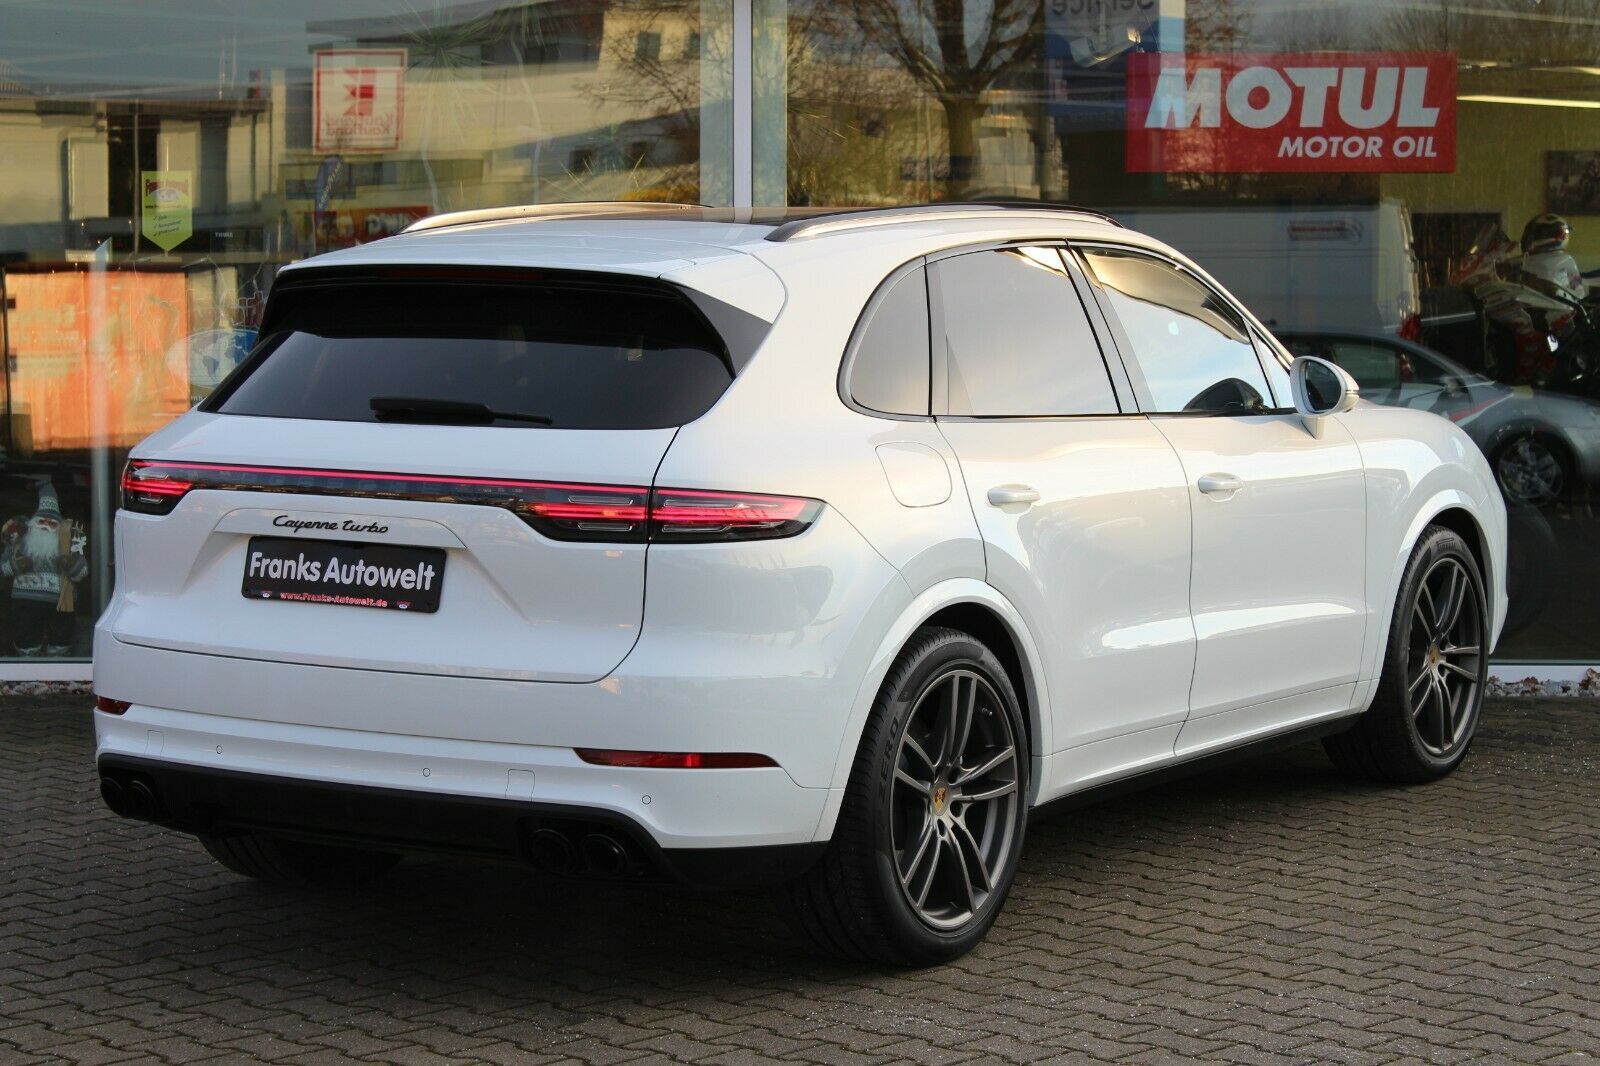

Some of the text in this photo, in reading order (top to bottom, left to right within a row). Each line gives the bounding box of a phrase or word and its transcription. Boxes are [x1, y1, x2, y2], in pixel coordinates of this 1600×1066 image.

[1144, 66, 1440, 129] MOTUL
[1277, 136, 1437, 158] MOTOR OIL
[272, 515, 389, 534] Cayenne turbo
[250, 551, 435, 591] Franks Autowelt
